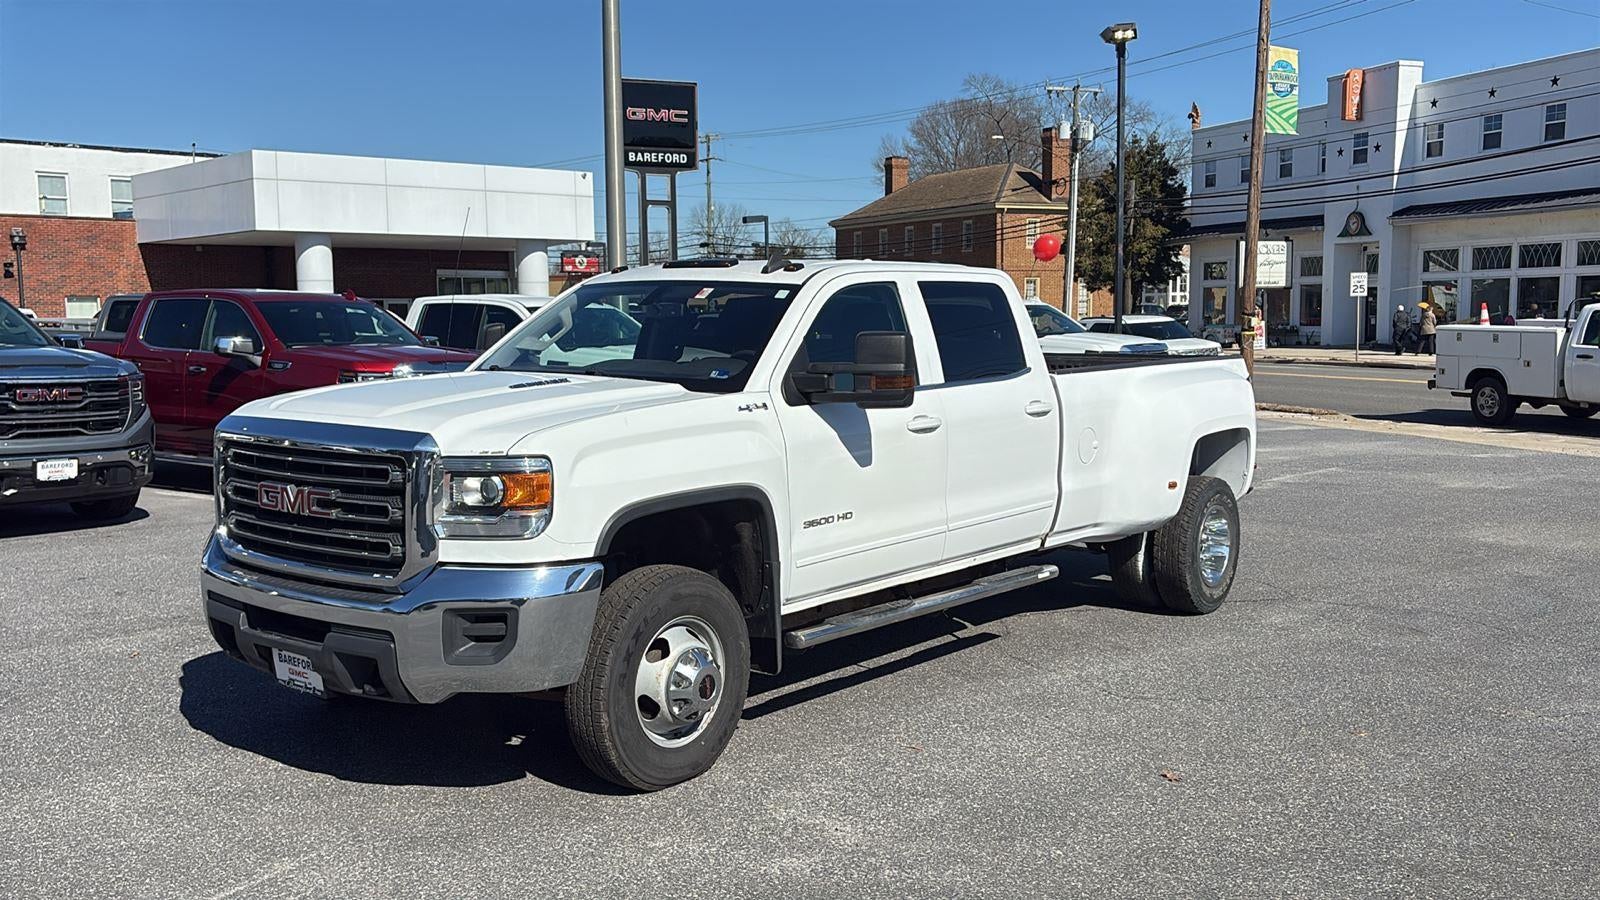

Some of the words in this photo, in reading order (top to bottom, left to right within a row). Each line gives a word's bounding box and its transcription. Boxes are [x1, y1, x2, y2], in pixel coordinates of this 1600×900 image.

[626, 107, 688, 122] GMC
[628, 152, 688, 164] BAREFORD
[1352, 284, 1366, 294] 25
[16, 387, 83, 401] GMC
[257, 482, 339, 517] GMC
[836, 511, 853, 522] HD
[278, 652, 313, 671] BAREFOR
[288, 667, 309, 680] GMC
